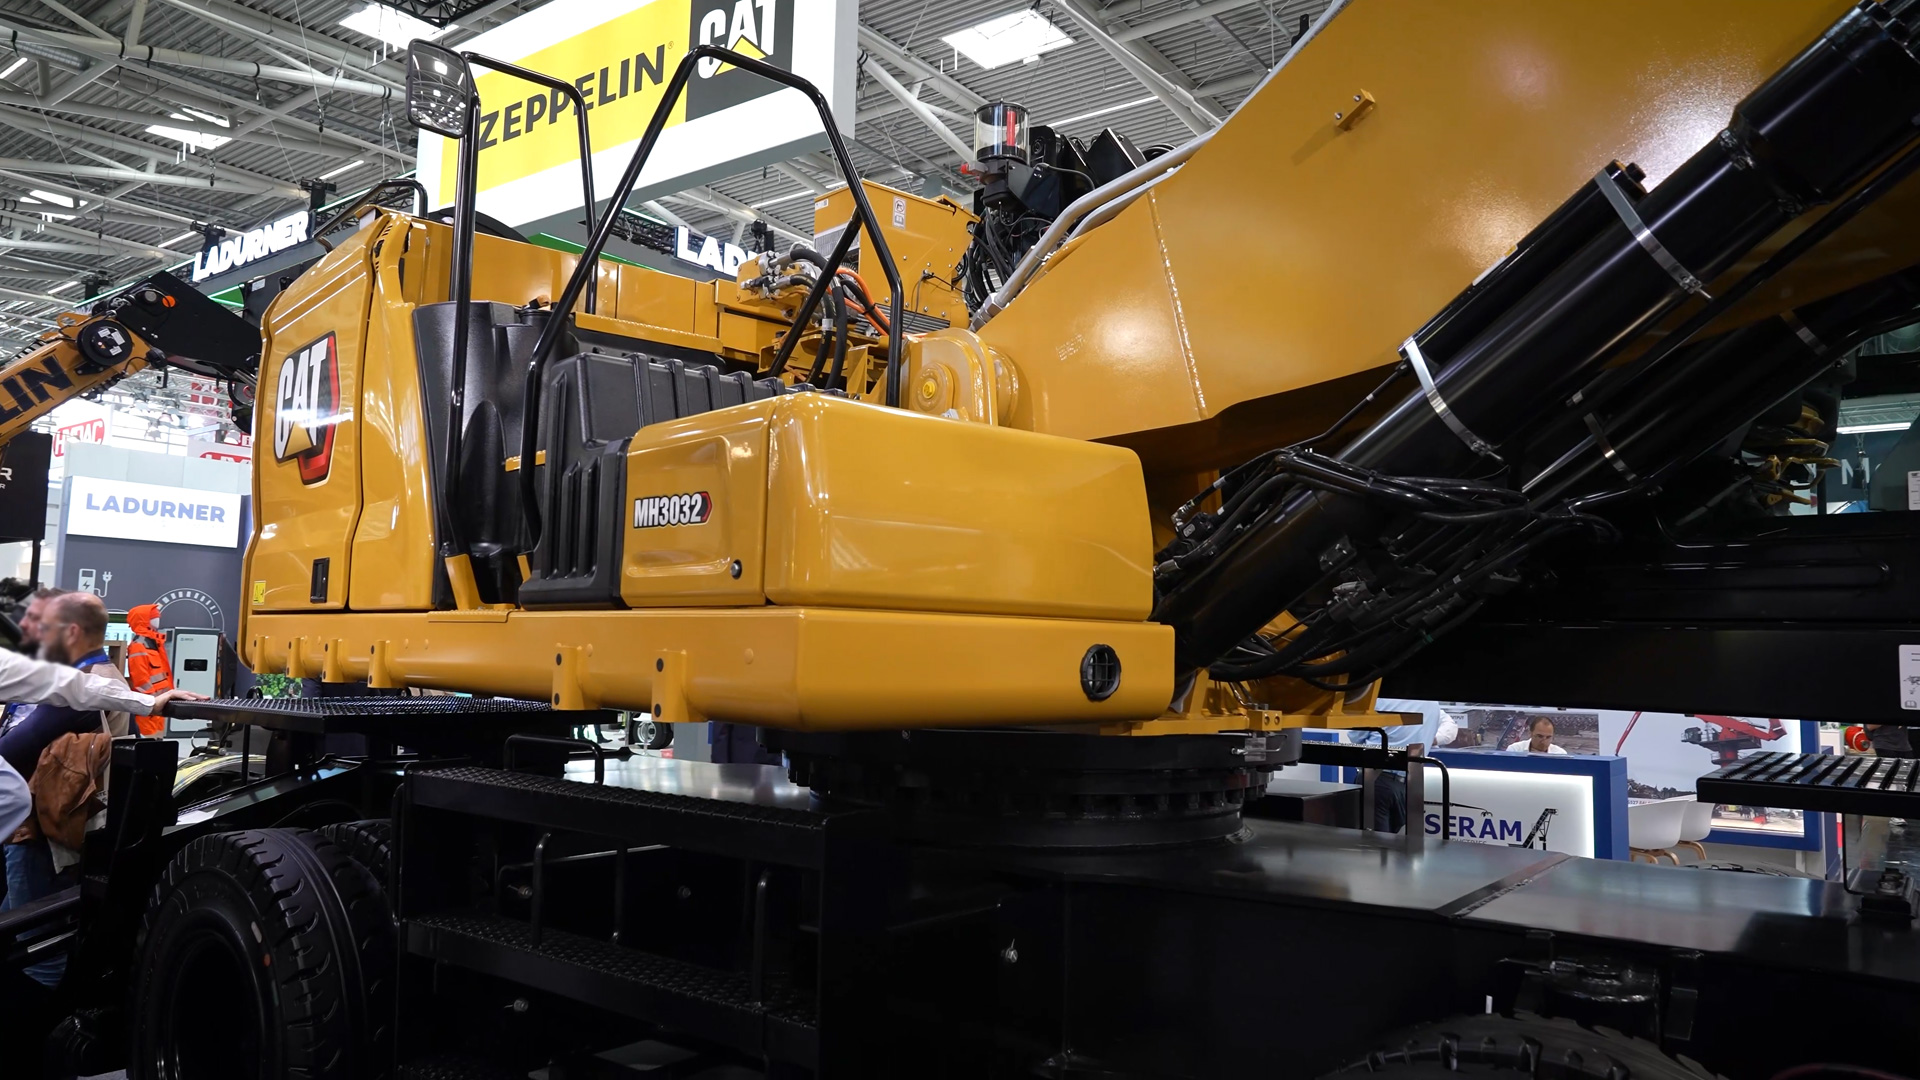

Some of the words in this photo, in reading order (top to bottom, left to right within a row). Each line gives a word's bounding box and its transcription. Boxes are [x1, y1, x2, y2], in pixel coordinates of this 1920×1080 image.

[698, 0, 776, 79] CAT
[192, 210, 309, 282] LADURNER
[677, 225, 758, 277] LAD
[275, 337, 329, 459] CAT
[86, 493, 226, 523] LADURNER
[633, 492, 703, 528] MH3032
[1424, 813, 1522, 842] SERAM
